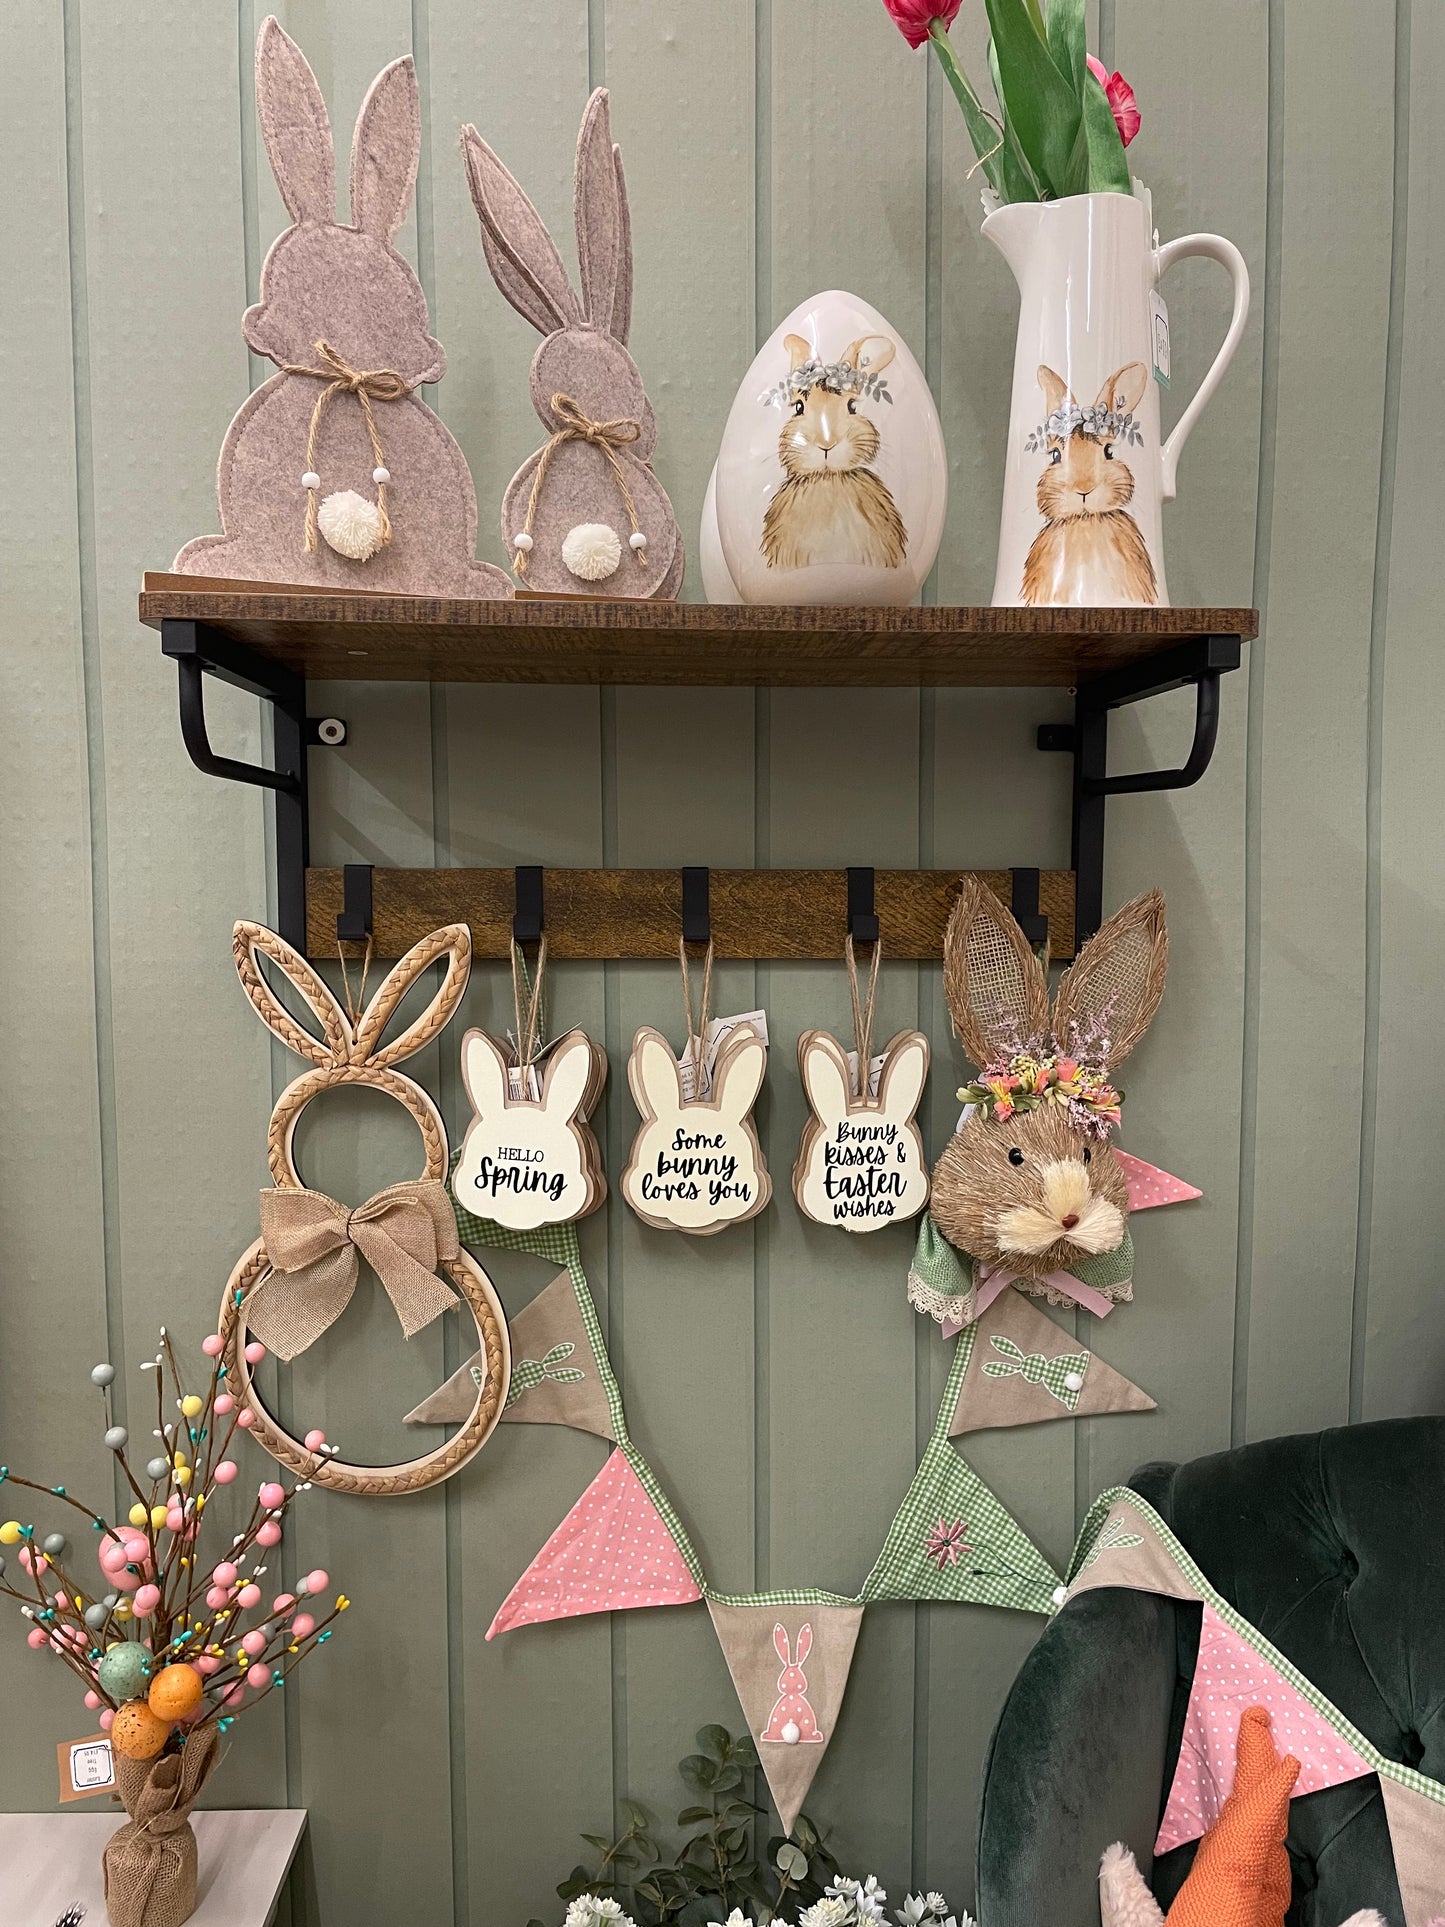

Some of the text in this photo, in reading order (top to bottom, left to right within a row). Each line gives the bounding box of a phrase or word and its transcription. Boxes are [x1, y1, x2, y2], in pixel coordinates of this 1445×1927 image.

[671, 1127, 727, 1151] Some
[835, 1121, 899, 1146] Bunny
[497, 1146, 544, 1163] HELLO
[657, 1151, 739, 1180] bunny
[824, 1141, 906, 1167] kisses &
[474, 1155, 568, 1202] Spring
[641, 1172, 752, 1206] loves you
[823, 1165, 908, 1200] Easter
[833, 1195, 896, 1219] wishes
